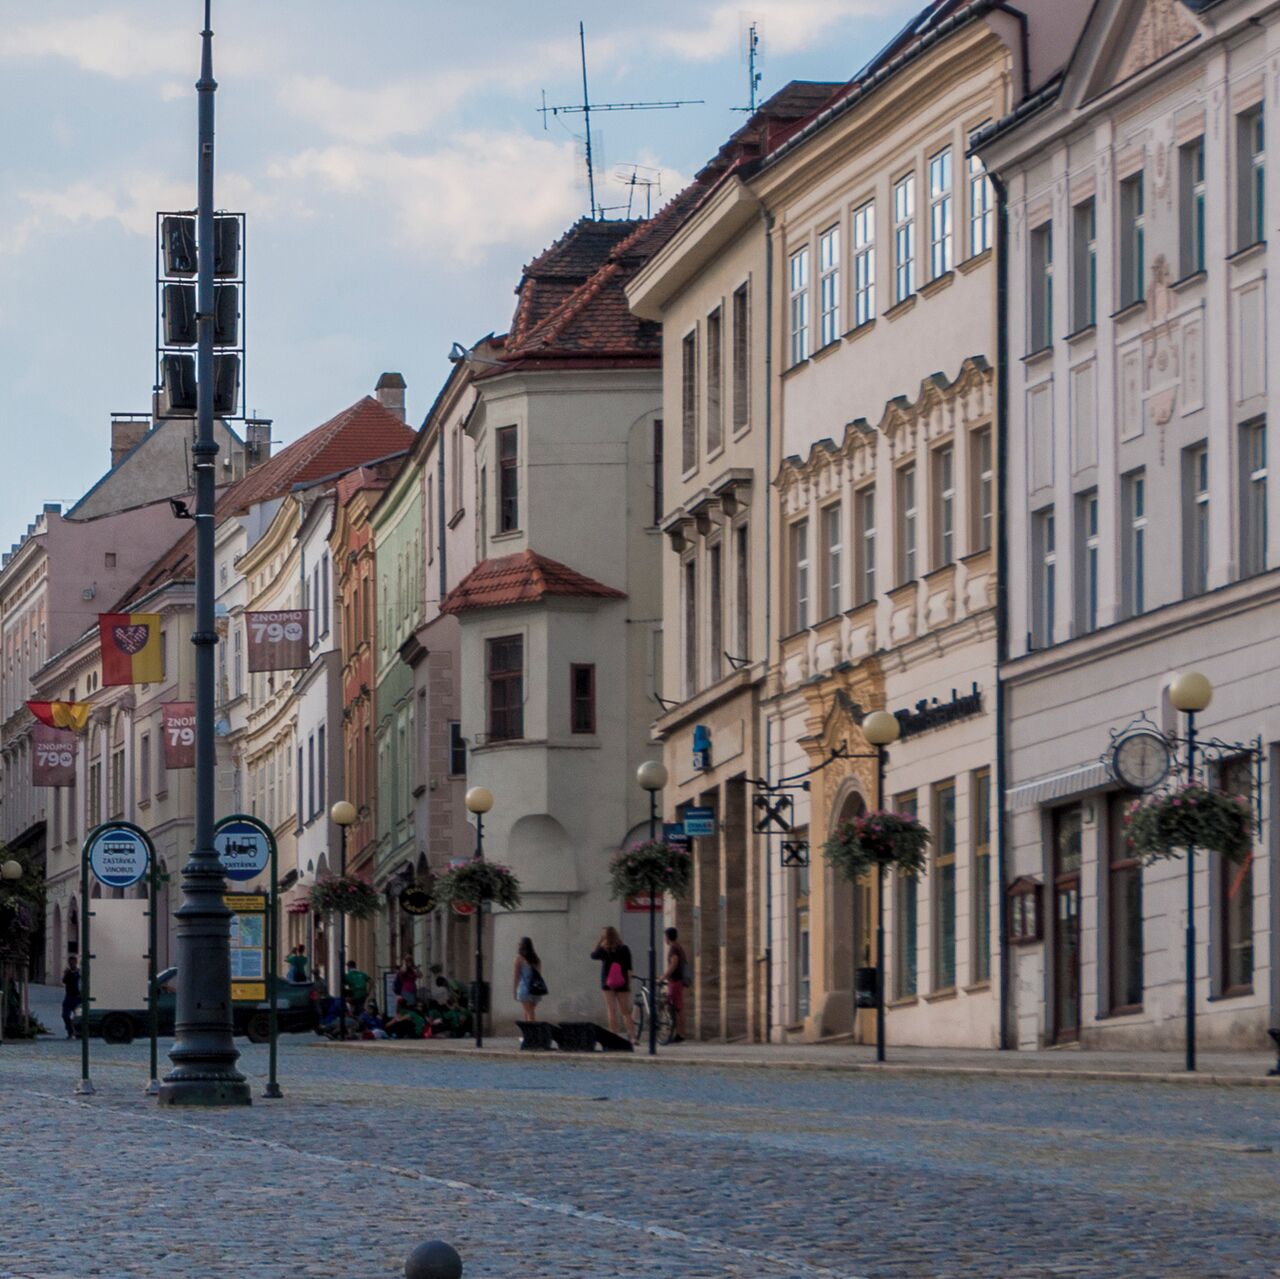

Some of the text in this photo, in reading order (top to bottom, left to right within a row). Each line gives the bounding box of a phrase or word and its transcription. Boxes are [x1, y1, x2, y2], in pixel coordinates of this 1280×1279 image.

[251, 611, 302, 622] ZNOJMO
[38, 743, 73, 752] ZNOJMO
[102, 856, 137, 865] ZASTÁVKA
